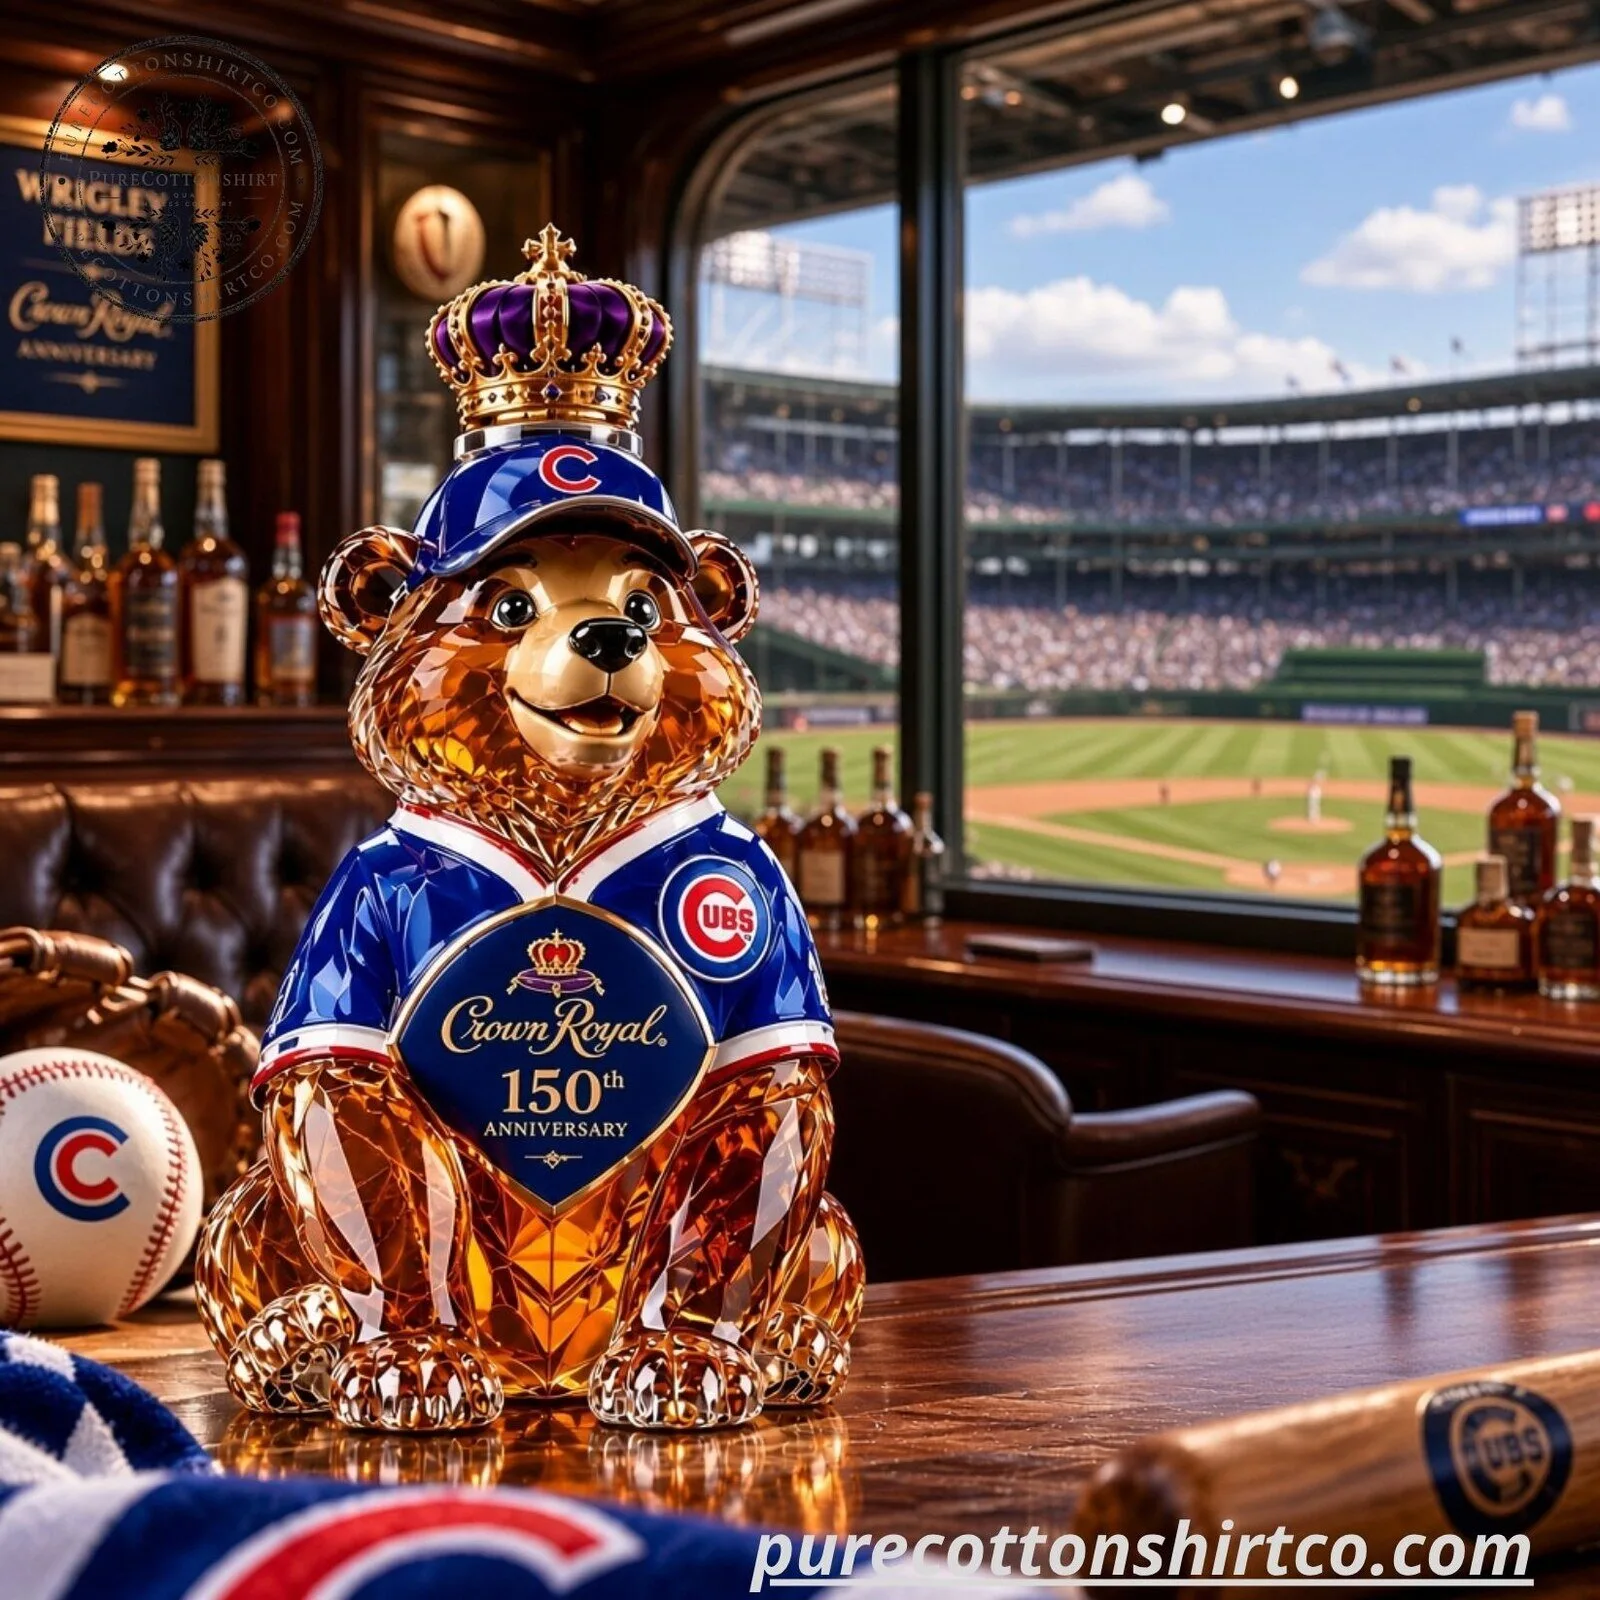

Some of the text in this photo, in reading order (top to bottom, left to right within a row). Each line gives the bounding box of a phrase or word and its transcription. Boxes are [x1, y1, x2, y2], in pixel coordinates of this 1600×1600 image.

[16, 168, 168, 218] WRIGLEY
[538, 444, 602, 495] C
[682, 876, 755, 960] CUBS
[441, 995, 549, 1054] Crown
[501, 1068, 625, 1116] 150th
[484, 1121, 629, 1139] ANNIVERSARY
